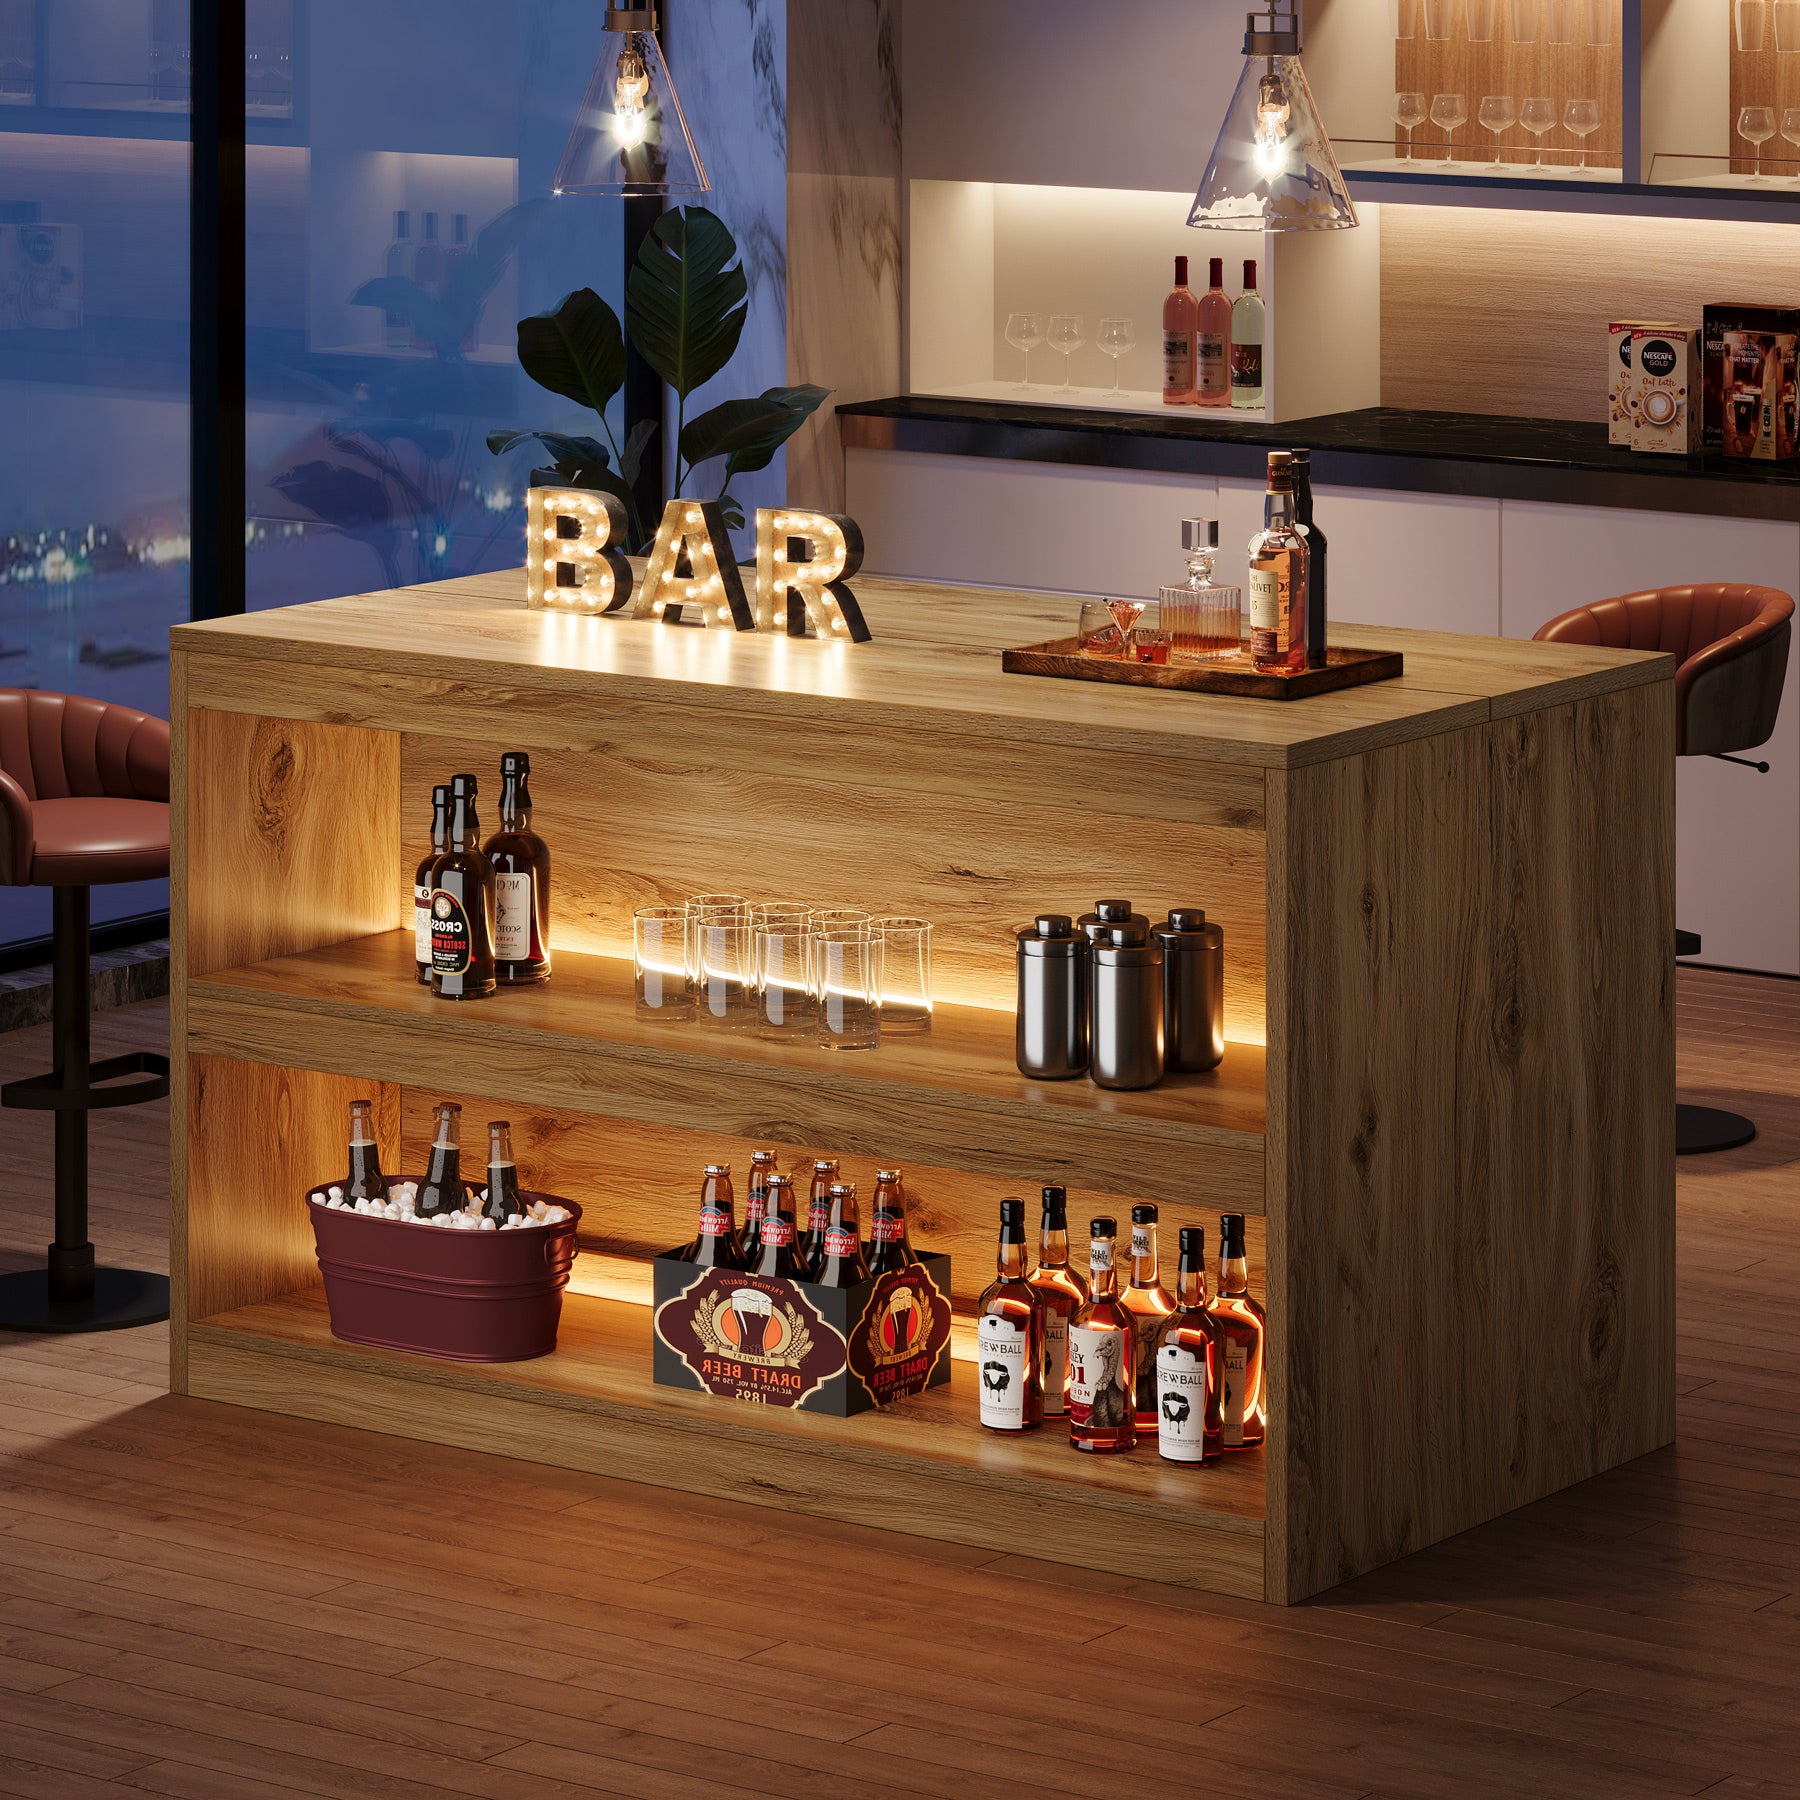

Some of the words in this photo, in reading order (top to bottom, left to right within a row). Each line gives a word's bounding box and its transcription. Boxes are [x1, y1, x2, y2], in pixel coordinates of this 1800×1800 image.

[1706, 340, 1724, 350] NESCA
[1644, 351, 1672, 360] NESCAFÉ
[1742, 356, 1760, 364] MATTER
[1634, 438, 1638, 446] 6
[527, 486, 872, 643] BAR
[1070, 1364, 1086, 1384] 01
